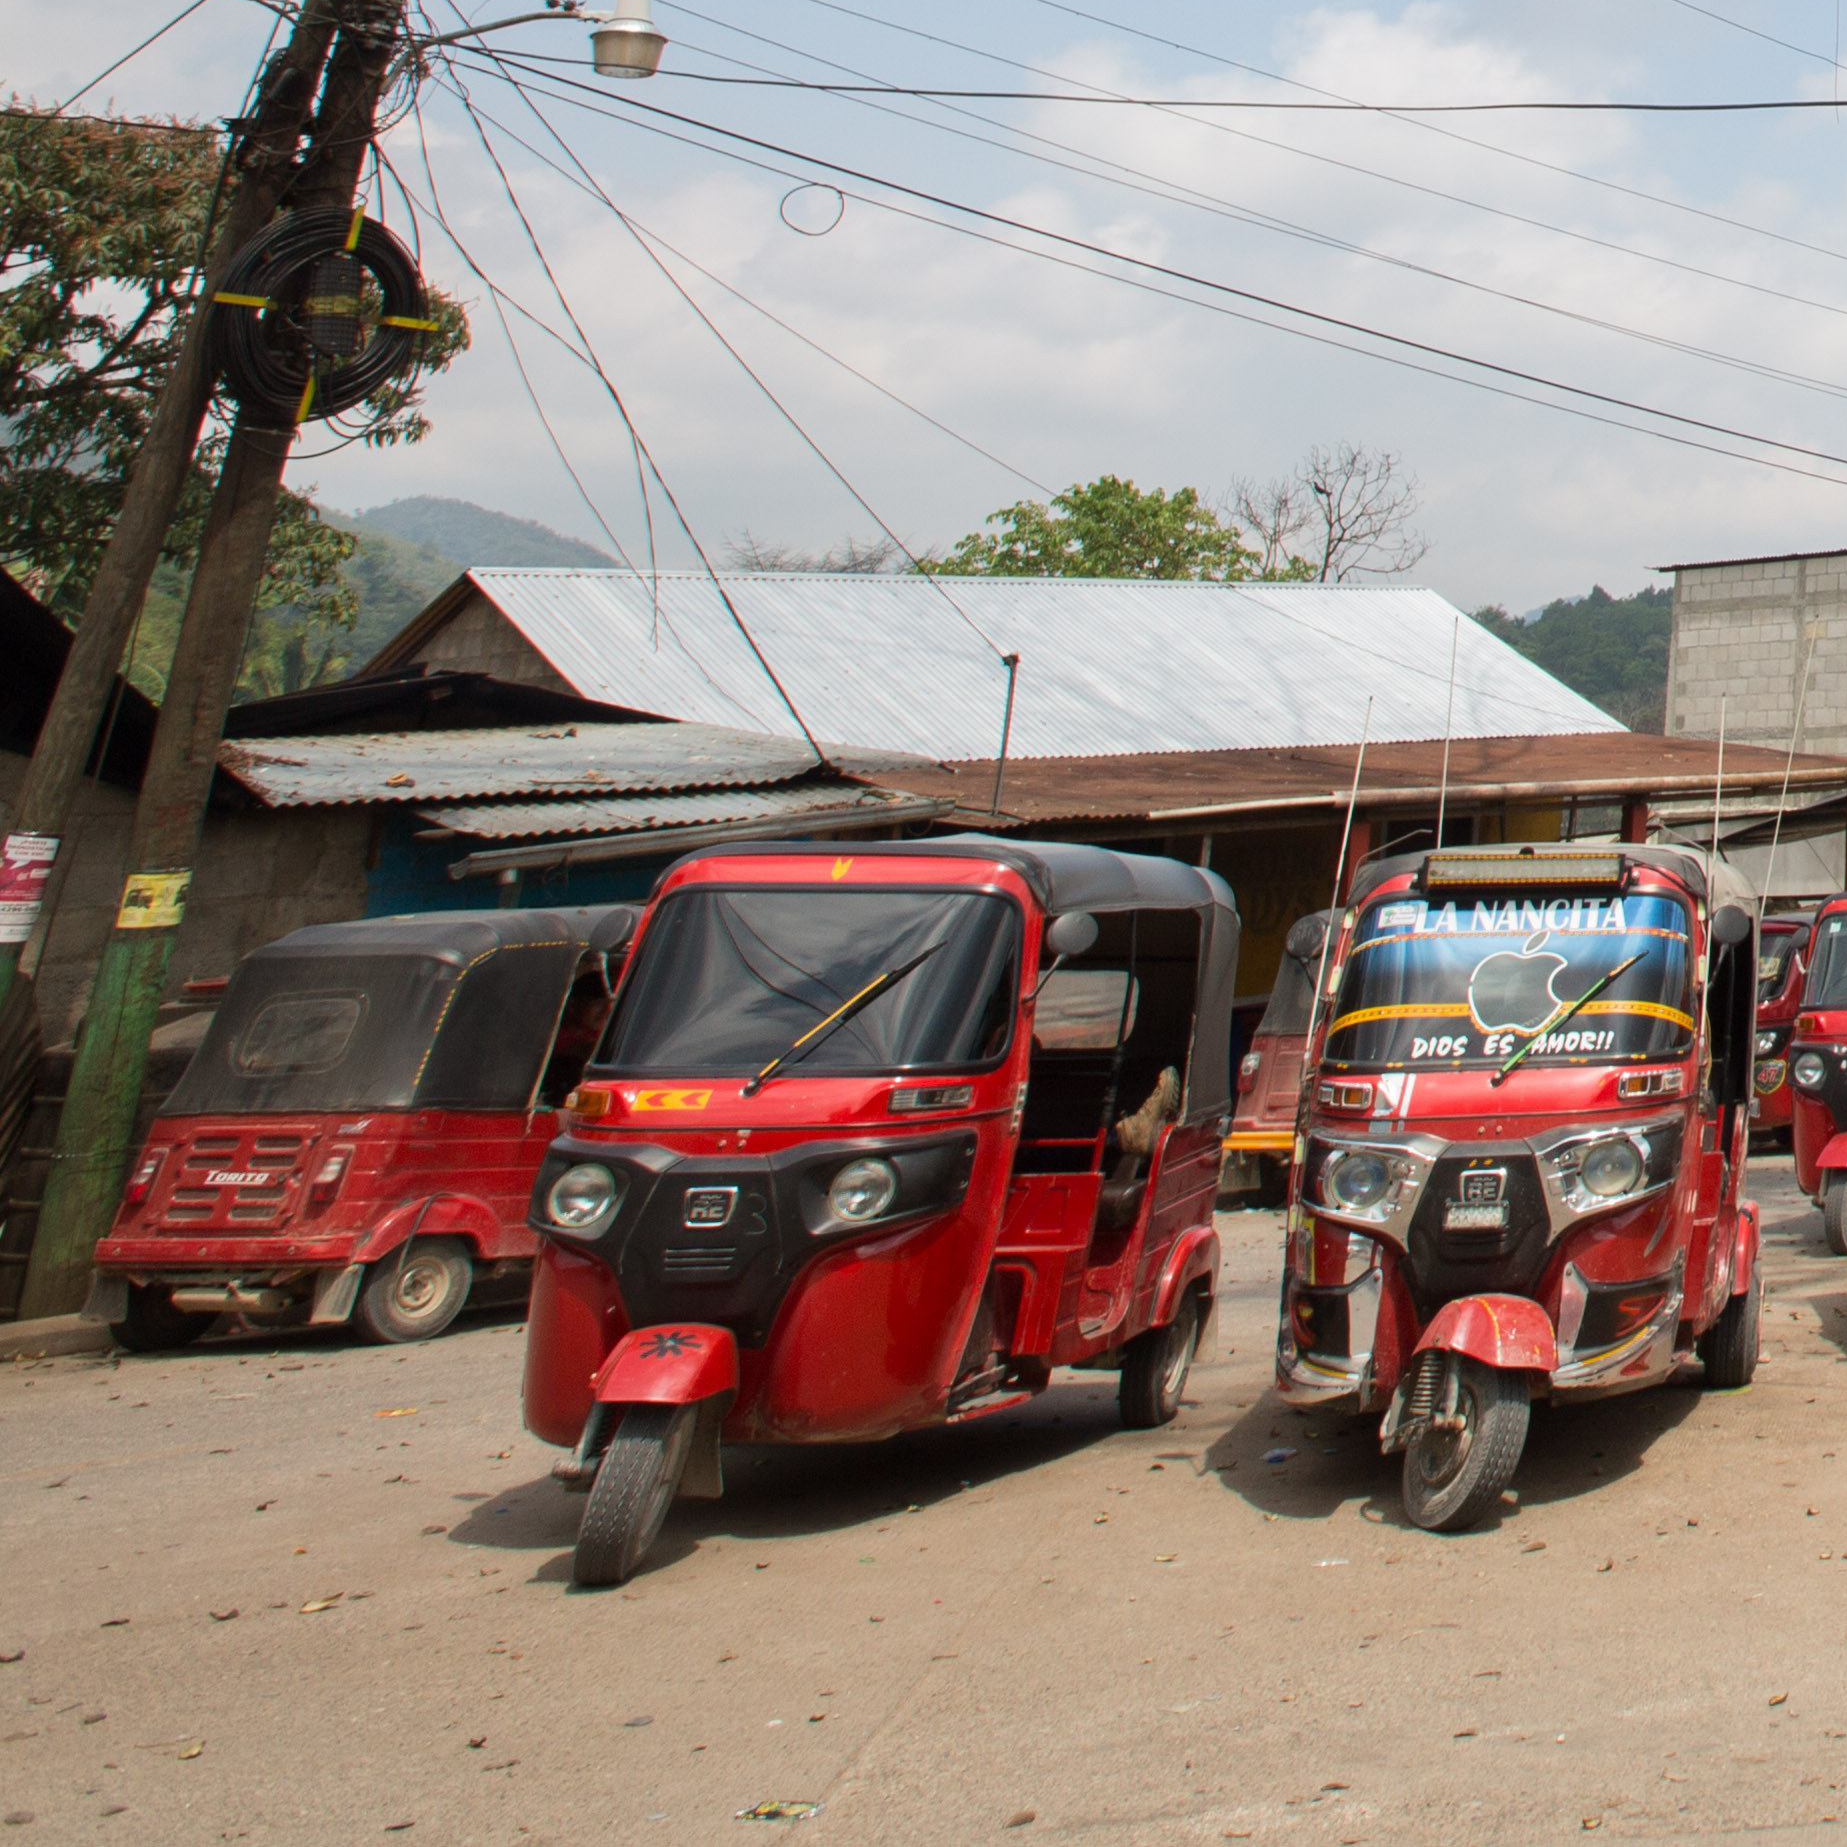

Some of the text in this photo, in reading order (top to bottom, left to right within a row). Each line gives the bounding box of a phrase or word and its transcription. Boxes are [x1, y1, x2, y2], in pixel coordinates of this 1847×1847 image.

[1413, 900, 1459, 933] LA
[1471, 897, 1628, 932] NANCITA
[1411, 1030, 1616, 1060] DIOS ES AMOR!!
[1757, 1068, 1779, 1084] 47
[204, 1170, 270, 1185] TORITO
[1468, 1181, 1498, 1201] RE
